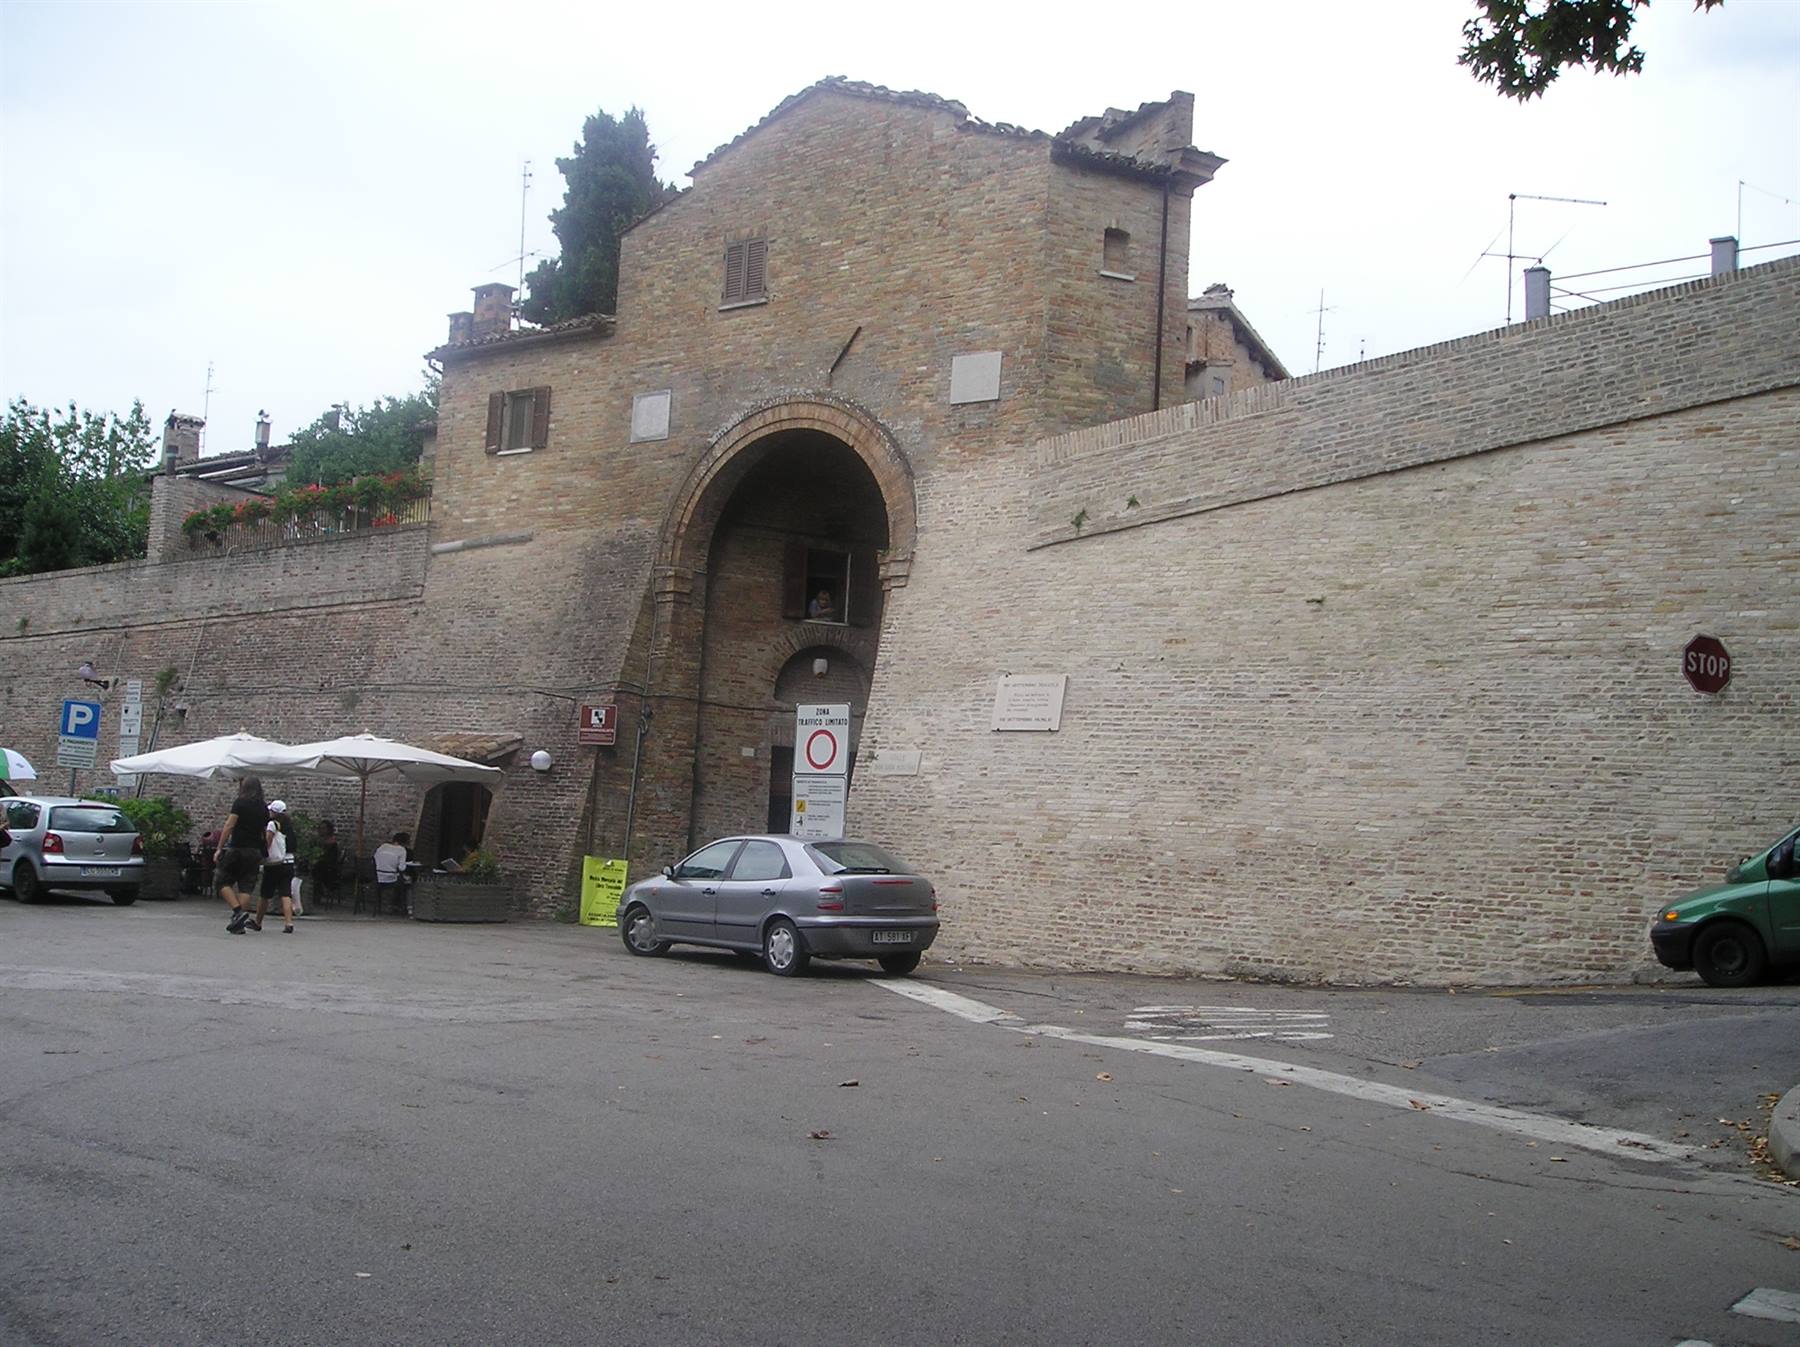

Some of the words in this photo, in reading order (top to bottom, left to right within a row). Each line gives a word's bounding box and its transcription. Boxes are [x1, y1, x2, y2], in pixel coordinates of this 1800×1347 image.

[1687, 651, 1728, 678] STOP
[67, 703, 94, 734] P
[816, 708, 829, 716] ZONA
[799, 718, 822, 726] TRAFFICO
[825, 718, 848, 726] LIMITATO
